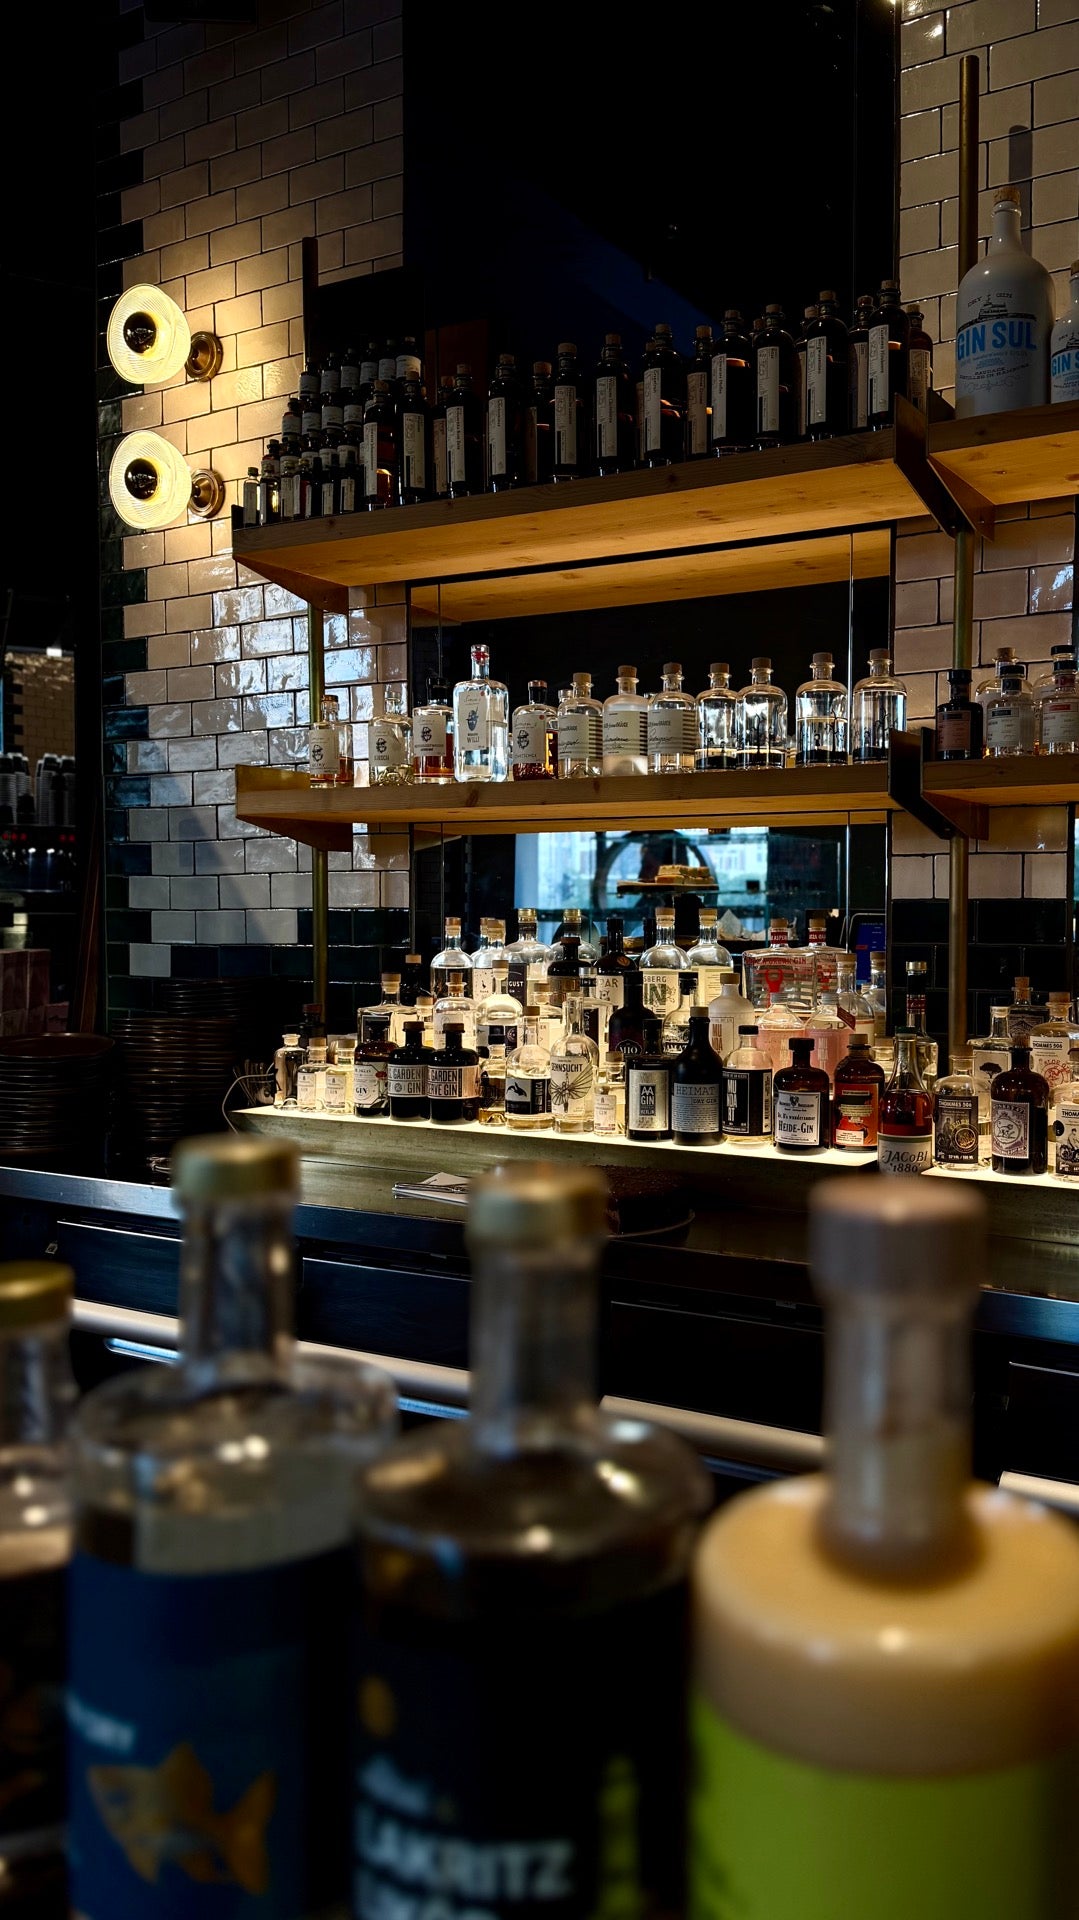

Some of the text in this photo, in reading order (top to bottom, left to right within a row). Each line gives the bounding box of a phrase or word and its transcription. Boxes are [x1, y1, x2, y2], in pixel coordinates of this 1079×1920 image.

[957, 321, 1037, 360] GIN SUL
[1052, 353, 1071, 377] GIN
[393, 1068, 420, 1080] GARDEN
[431, 1069, 457, 1082] GARDEN
[407, 1082, 421, 1093] GIN
[444, 1084, 457, 1096] GIN
[640, 1095, 655, 1105] GIN
[778, 1120, 814, 1134] HEIDE-GIN
[354, 1803, 576, 1901] LAKRITZ
